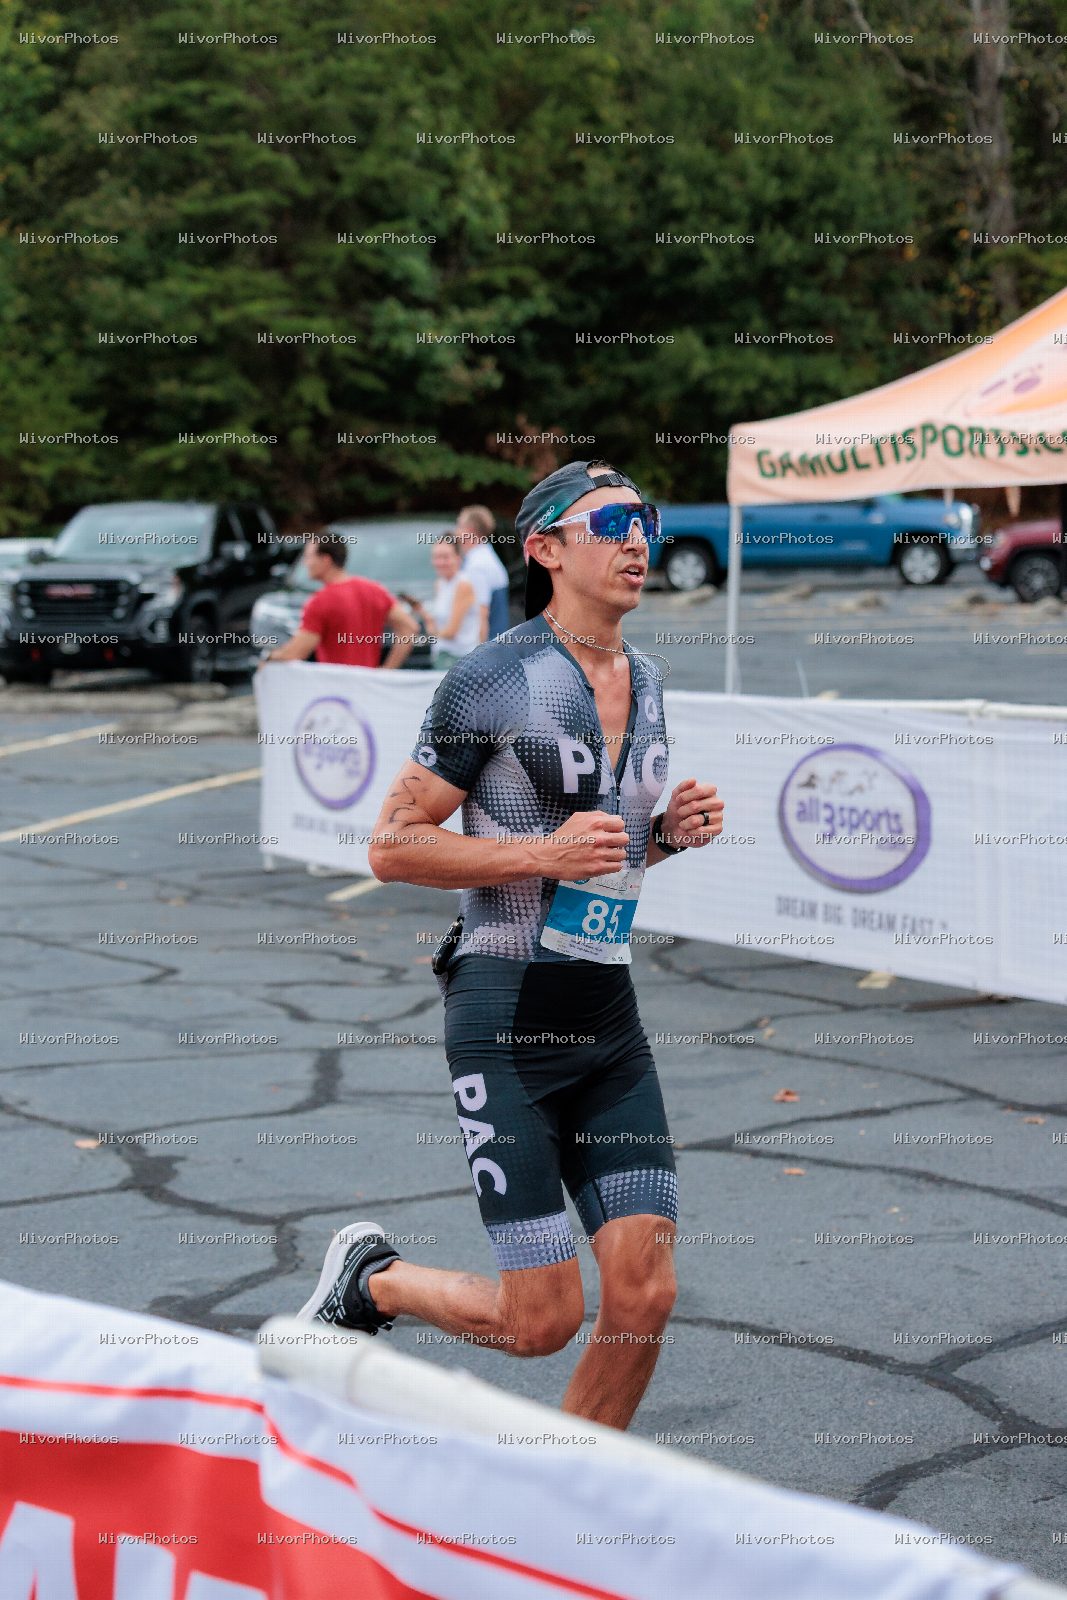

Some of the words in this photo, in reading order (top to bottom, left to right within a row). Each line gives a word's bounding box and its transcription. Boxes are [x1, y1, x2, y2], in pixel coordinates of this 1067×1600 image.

[558, 738, 669, 797] PAC
[582, 900, 623, 940] 85
[452, 1073, 507, 1197] PAC
